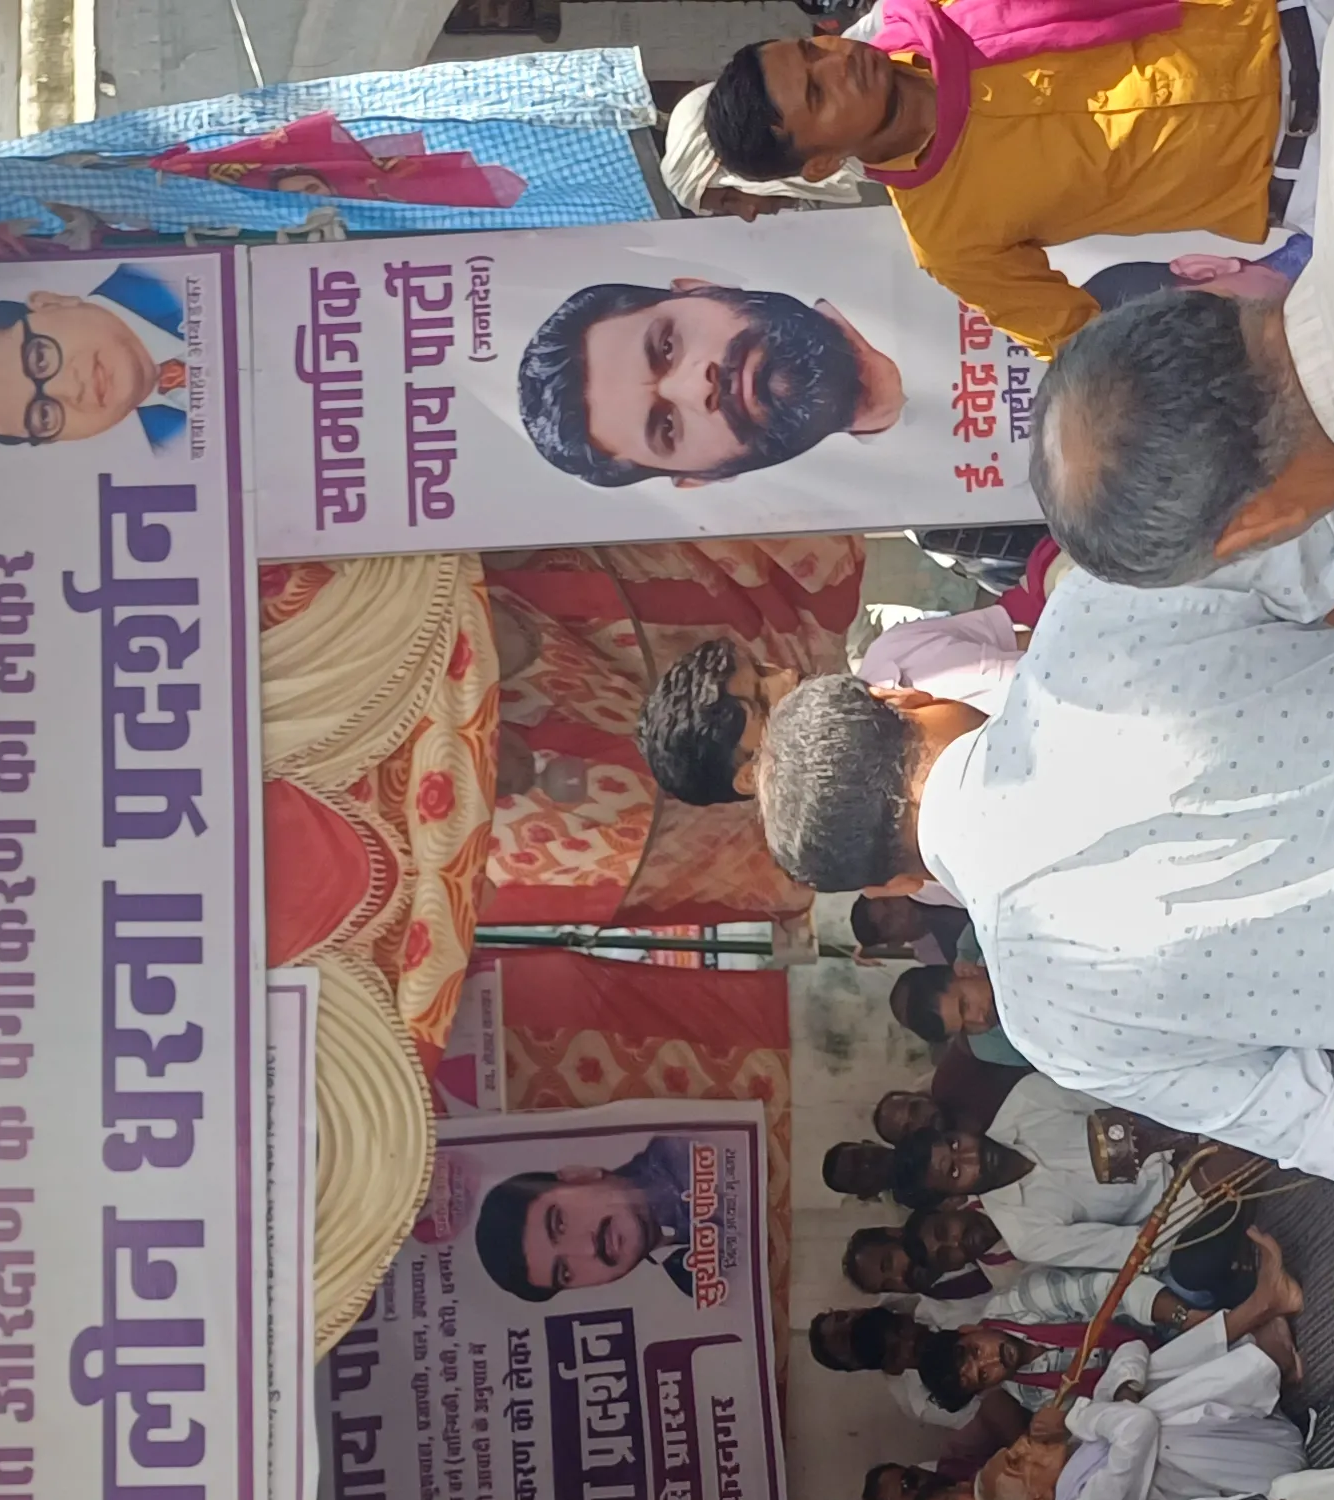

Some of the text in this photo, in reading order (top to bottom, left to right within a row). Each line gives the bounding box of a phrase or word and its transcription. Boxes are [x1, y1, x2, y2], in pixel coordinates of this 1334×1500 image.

[465, 255, 498, 362] (जनादेश)
[189, 418, 206, 460] बाबा
[295, 267, 367, 530] सामाजिक
[383, 260, 457, 527] न्याय पार्टी
[951, 361, 999, 442] देवेंद्र
[954, 451, 1005, 492] ई.
[62, 473, 208, 847] प्रदर्शन
[99, 880, 207, 1173] धरना
[682, 1142, 727, 1311] सुशील पांचाल
[501, 1327, 533, 1391] लेकर
[558, 1320, 633, 1470] प्रदर्शन
[503, 1397, 534, 1431] को
[654, 1368, 691, 1468] प्रारम्भ
